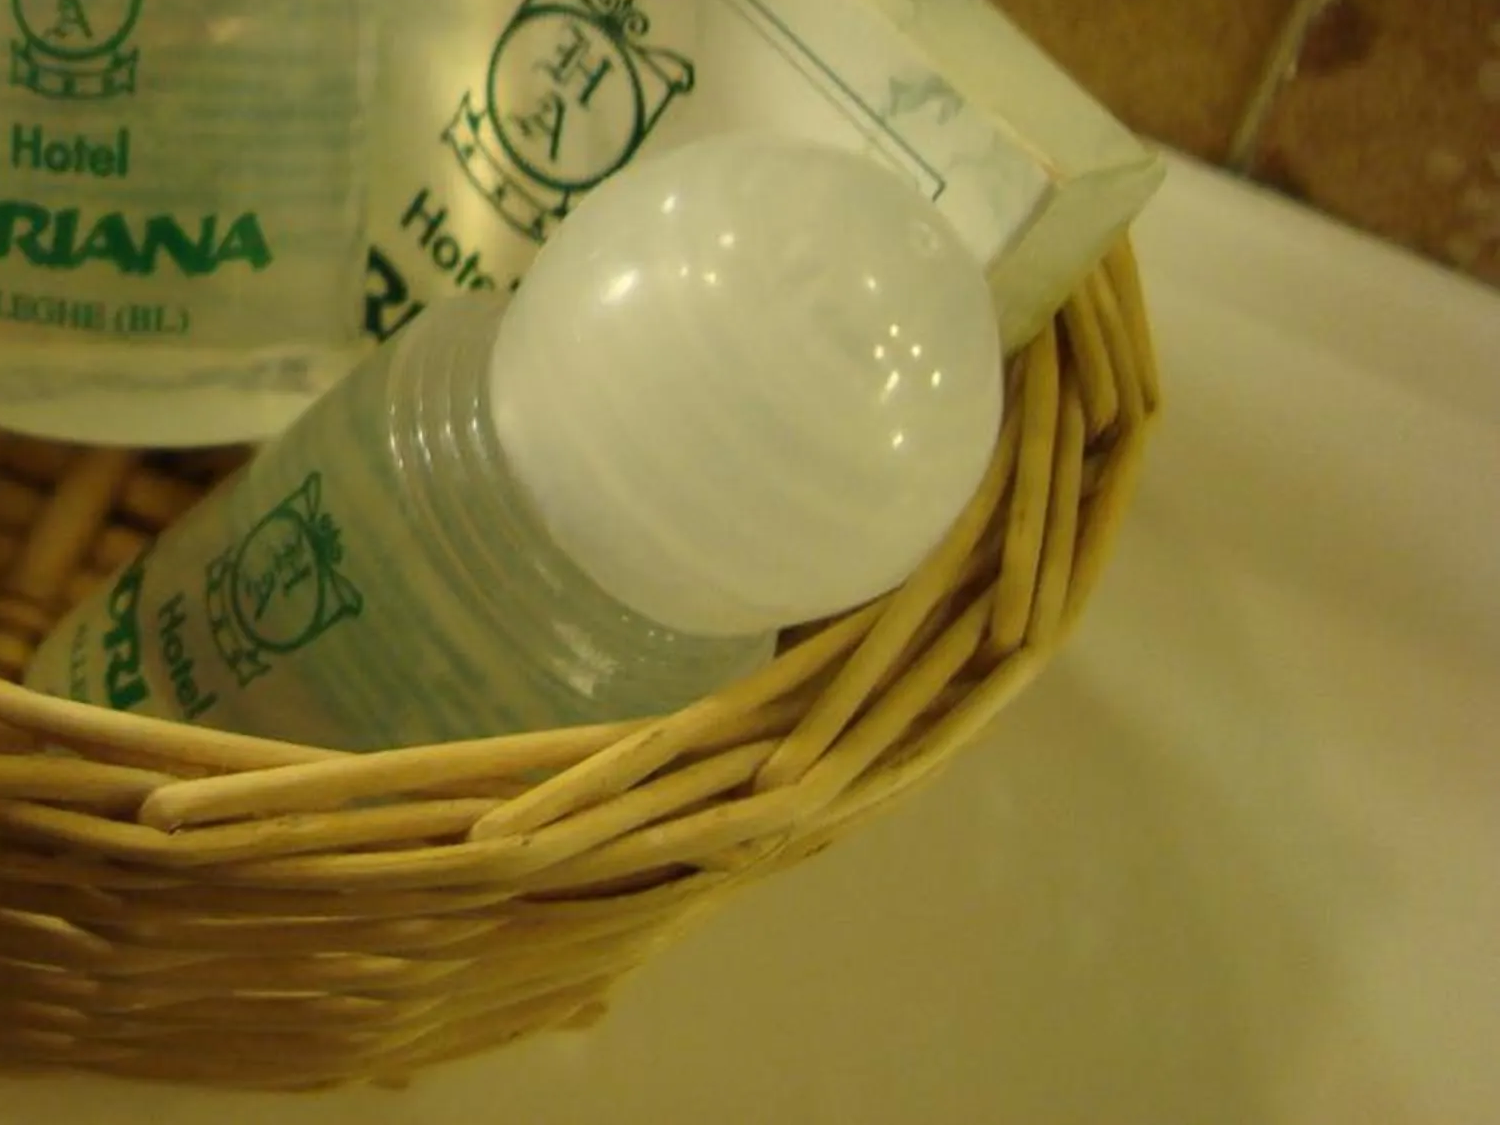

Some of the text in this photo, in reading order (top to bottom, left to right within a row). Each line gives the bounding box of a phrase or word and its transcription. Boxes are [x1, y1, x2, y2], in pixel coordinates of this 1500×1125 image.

[10, 123, 130, 178] Hotel
[401, 187, 521, 293] Hot
[156, 589, 220, 722] Hotel
